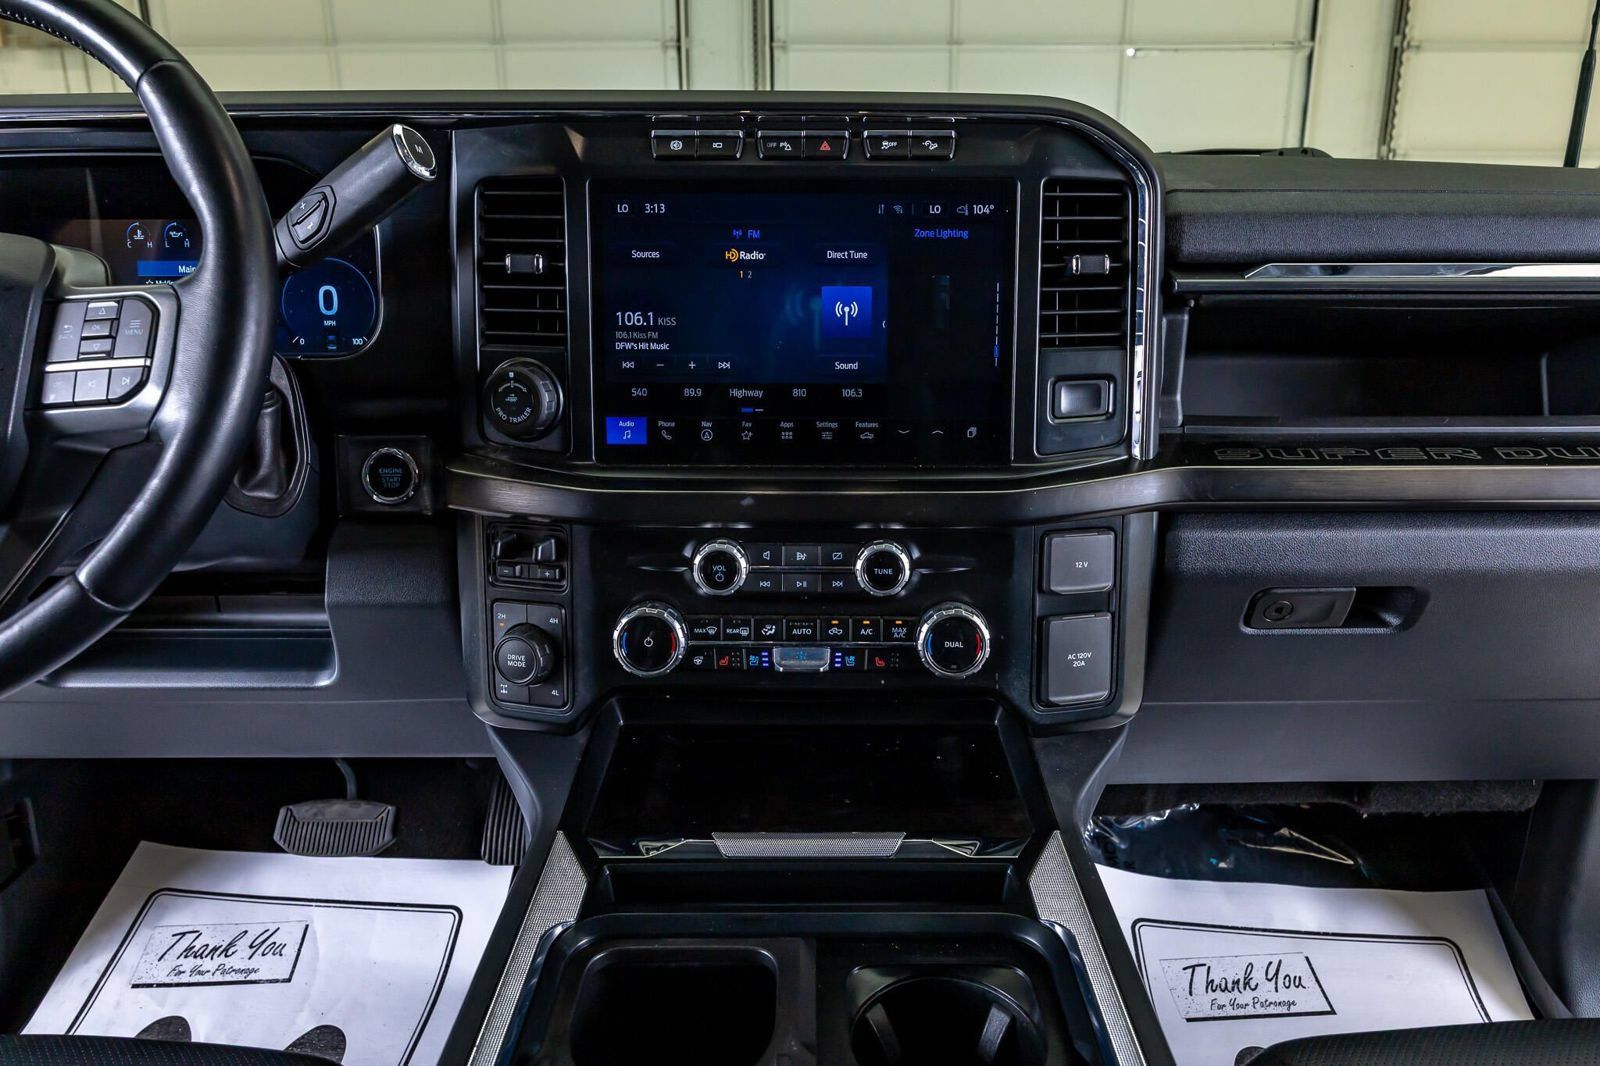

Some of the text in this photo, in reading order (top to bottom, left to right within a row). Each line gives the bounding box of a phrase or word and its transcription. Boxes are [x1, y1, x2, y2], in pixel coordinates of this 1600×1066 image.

[617, 204, 629, 213] LO
[644, 203, 666, 214] 3:13
[929, 204, 941, 214] LO
[747, 229, 761, 239] FM
[914, 228, 969, 240] Zone Lighting
[631, 249, 660, 259] Sources
[739, 250, 765, 260] Radio
[826, 250, 868, 260] Direct Tune
[747, 270, 753, 279] 2
[318, 284, 339, 316] 0
[615, 311, 677, 326] 106.1 KISS
[615, 331, 659, 340] 106.1 Kiss FM
[300, 338, 305, 346] 0
[352, 338, 364, 346] 100
[638, 342, 649, 350] Hit
[649, 342, 670, 350] Music
[834, 361, 859, 371] Sound
[631, 388, 648, 397] 540
[683, 388, 702, 397] 89.9
[729, 388, 764, 399] Highway
[792, 388, 807, 398] 810
[841, 388, 863, 398] 106.3
[495, 407, 533, 424] PRO TRAILER
[618, 420, 635, 428] Audio
[657, 420, 676, 428] Phone
[779, 421, 794, 429] Apps
[815, 420, 839, 429] Settings
[855, 421, 879, 429] Features
[1213, 446, 1482, 461] SUPER
[507, 653, 526, 662] DRIVE
[1077, 652, 1092, 660] 120V
[507, 660, 527, 668] MODE
[1072, 660, 1086, 668] 20A
[157, 926, 288, 963] Thank You
[166, 963, 261, 979] For Your Patronage
[1182, 958, 1307, 997] Thank You
[1210, 996, 1298, 1012] For Your Patronage
